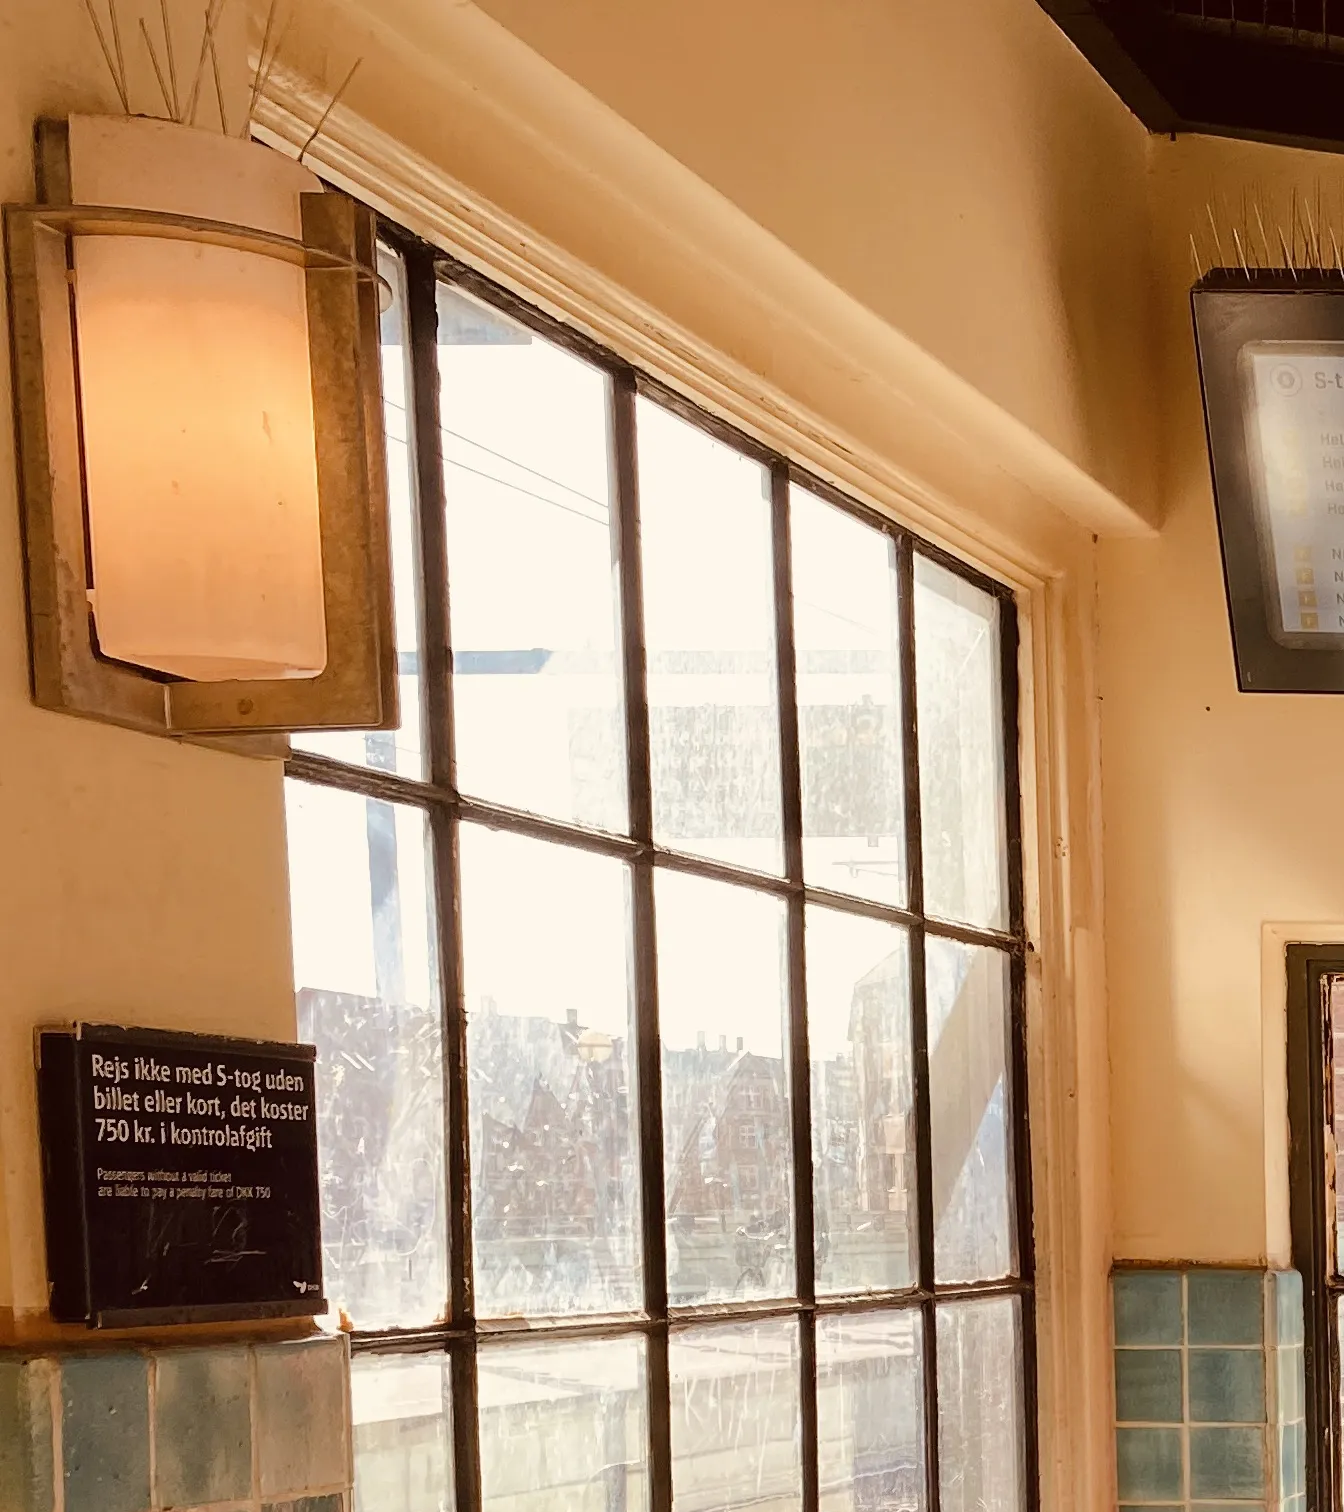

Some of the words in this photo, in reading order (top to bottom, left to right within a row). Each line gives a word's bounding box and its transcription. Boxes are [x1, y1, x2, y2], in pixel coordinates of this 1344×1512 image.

[92, 1054, 130, 1084] Rejs
[135, 1058, 170, 1082] ikke
[176, 1064, 212, 1085] med
[217, 1064, 261, 1093] S-tog
[266, 1070, 304, 1092] uden
[94, 1086, 140, 1112] billet
[145, 1090, 182, 1114] eller
[186, 1093, 226, 1120] kort,
[230, 1096, 256, 1120] det
[261, 1098, 309, 1121] koster
[95, 1118, 130, 1142] 750
[134, 1120, 156, 1144] kr.
[160, 1122, 166, 1144] i
[171, 1125, 272, 1152] kontrolafgift
